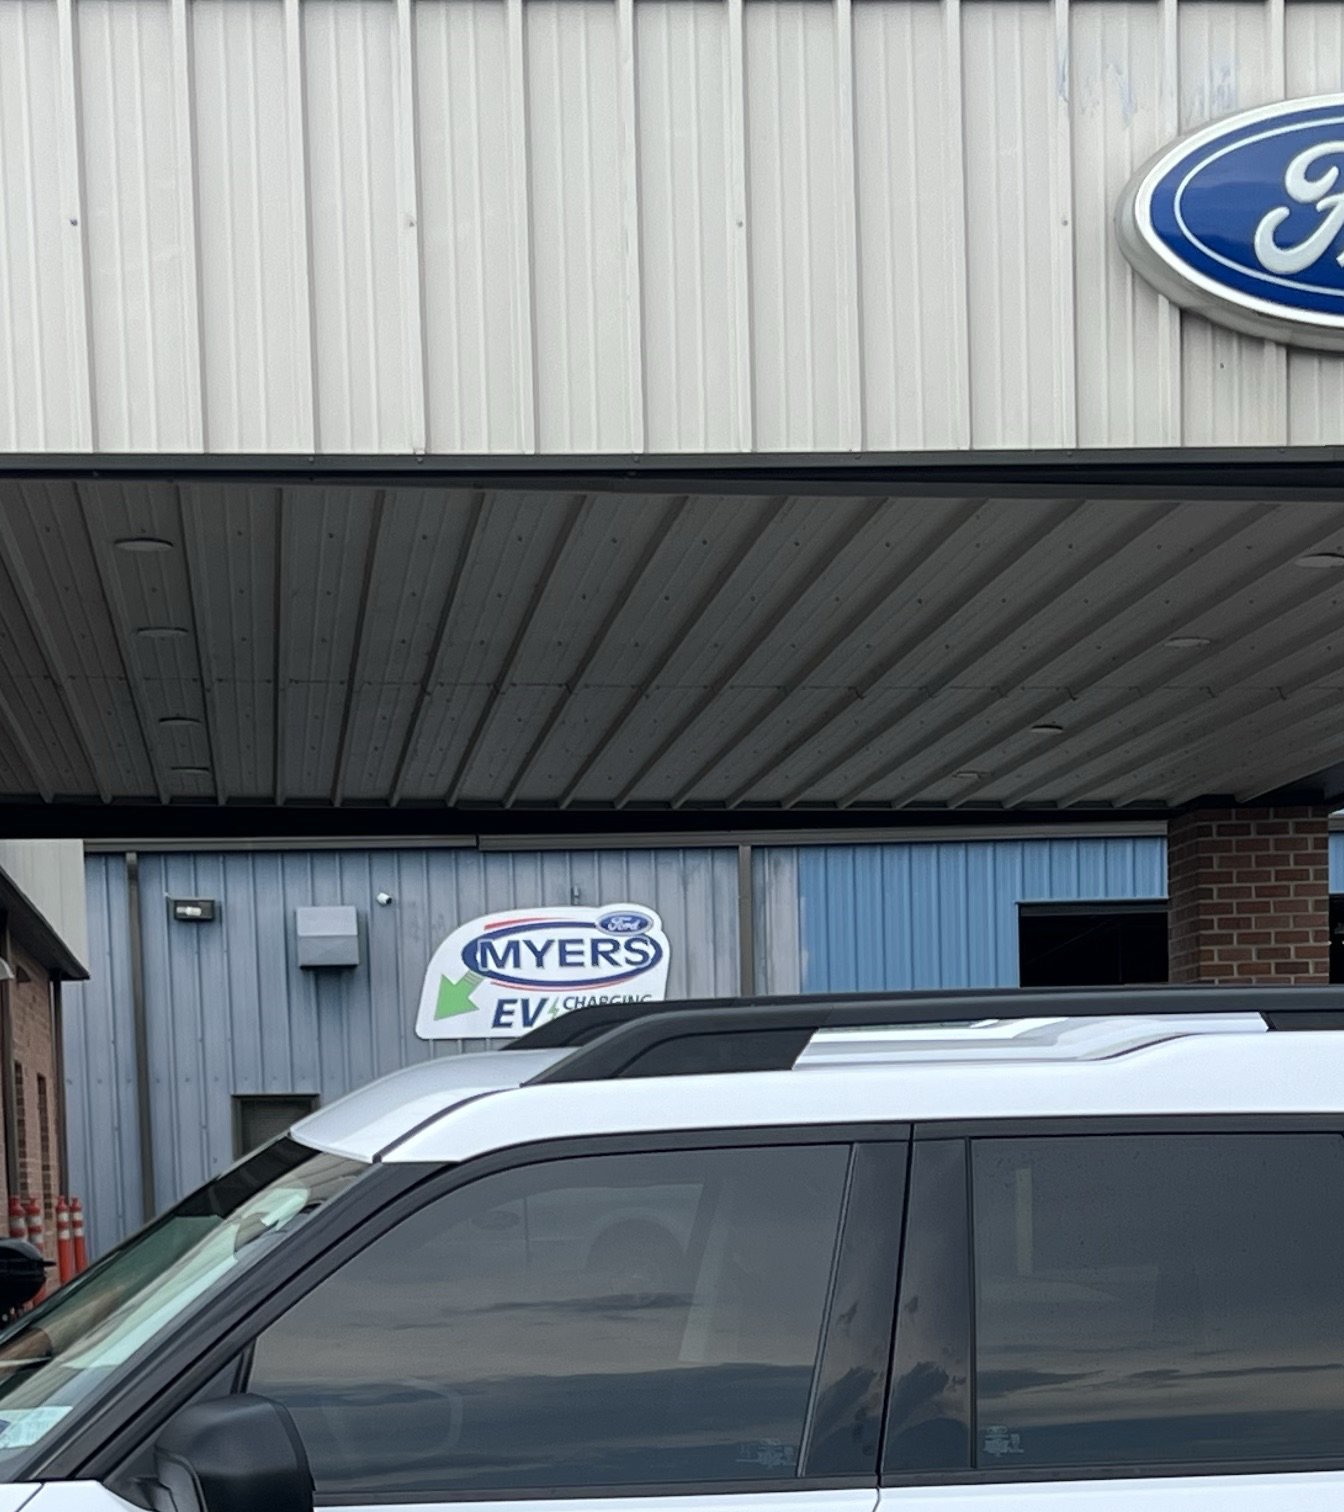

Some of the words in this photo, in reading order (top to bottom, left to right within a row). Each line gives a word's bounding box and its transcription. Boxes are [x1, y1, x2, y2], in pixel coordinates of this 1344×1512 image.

[607, 916, 640, 931] Ford
[480, 936, 651, 969] MYERS
[492, 998, 549, 1029] EV
